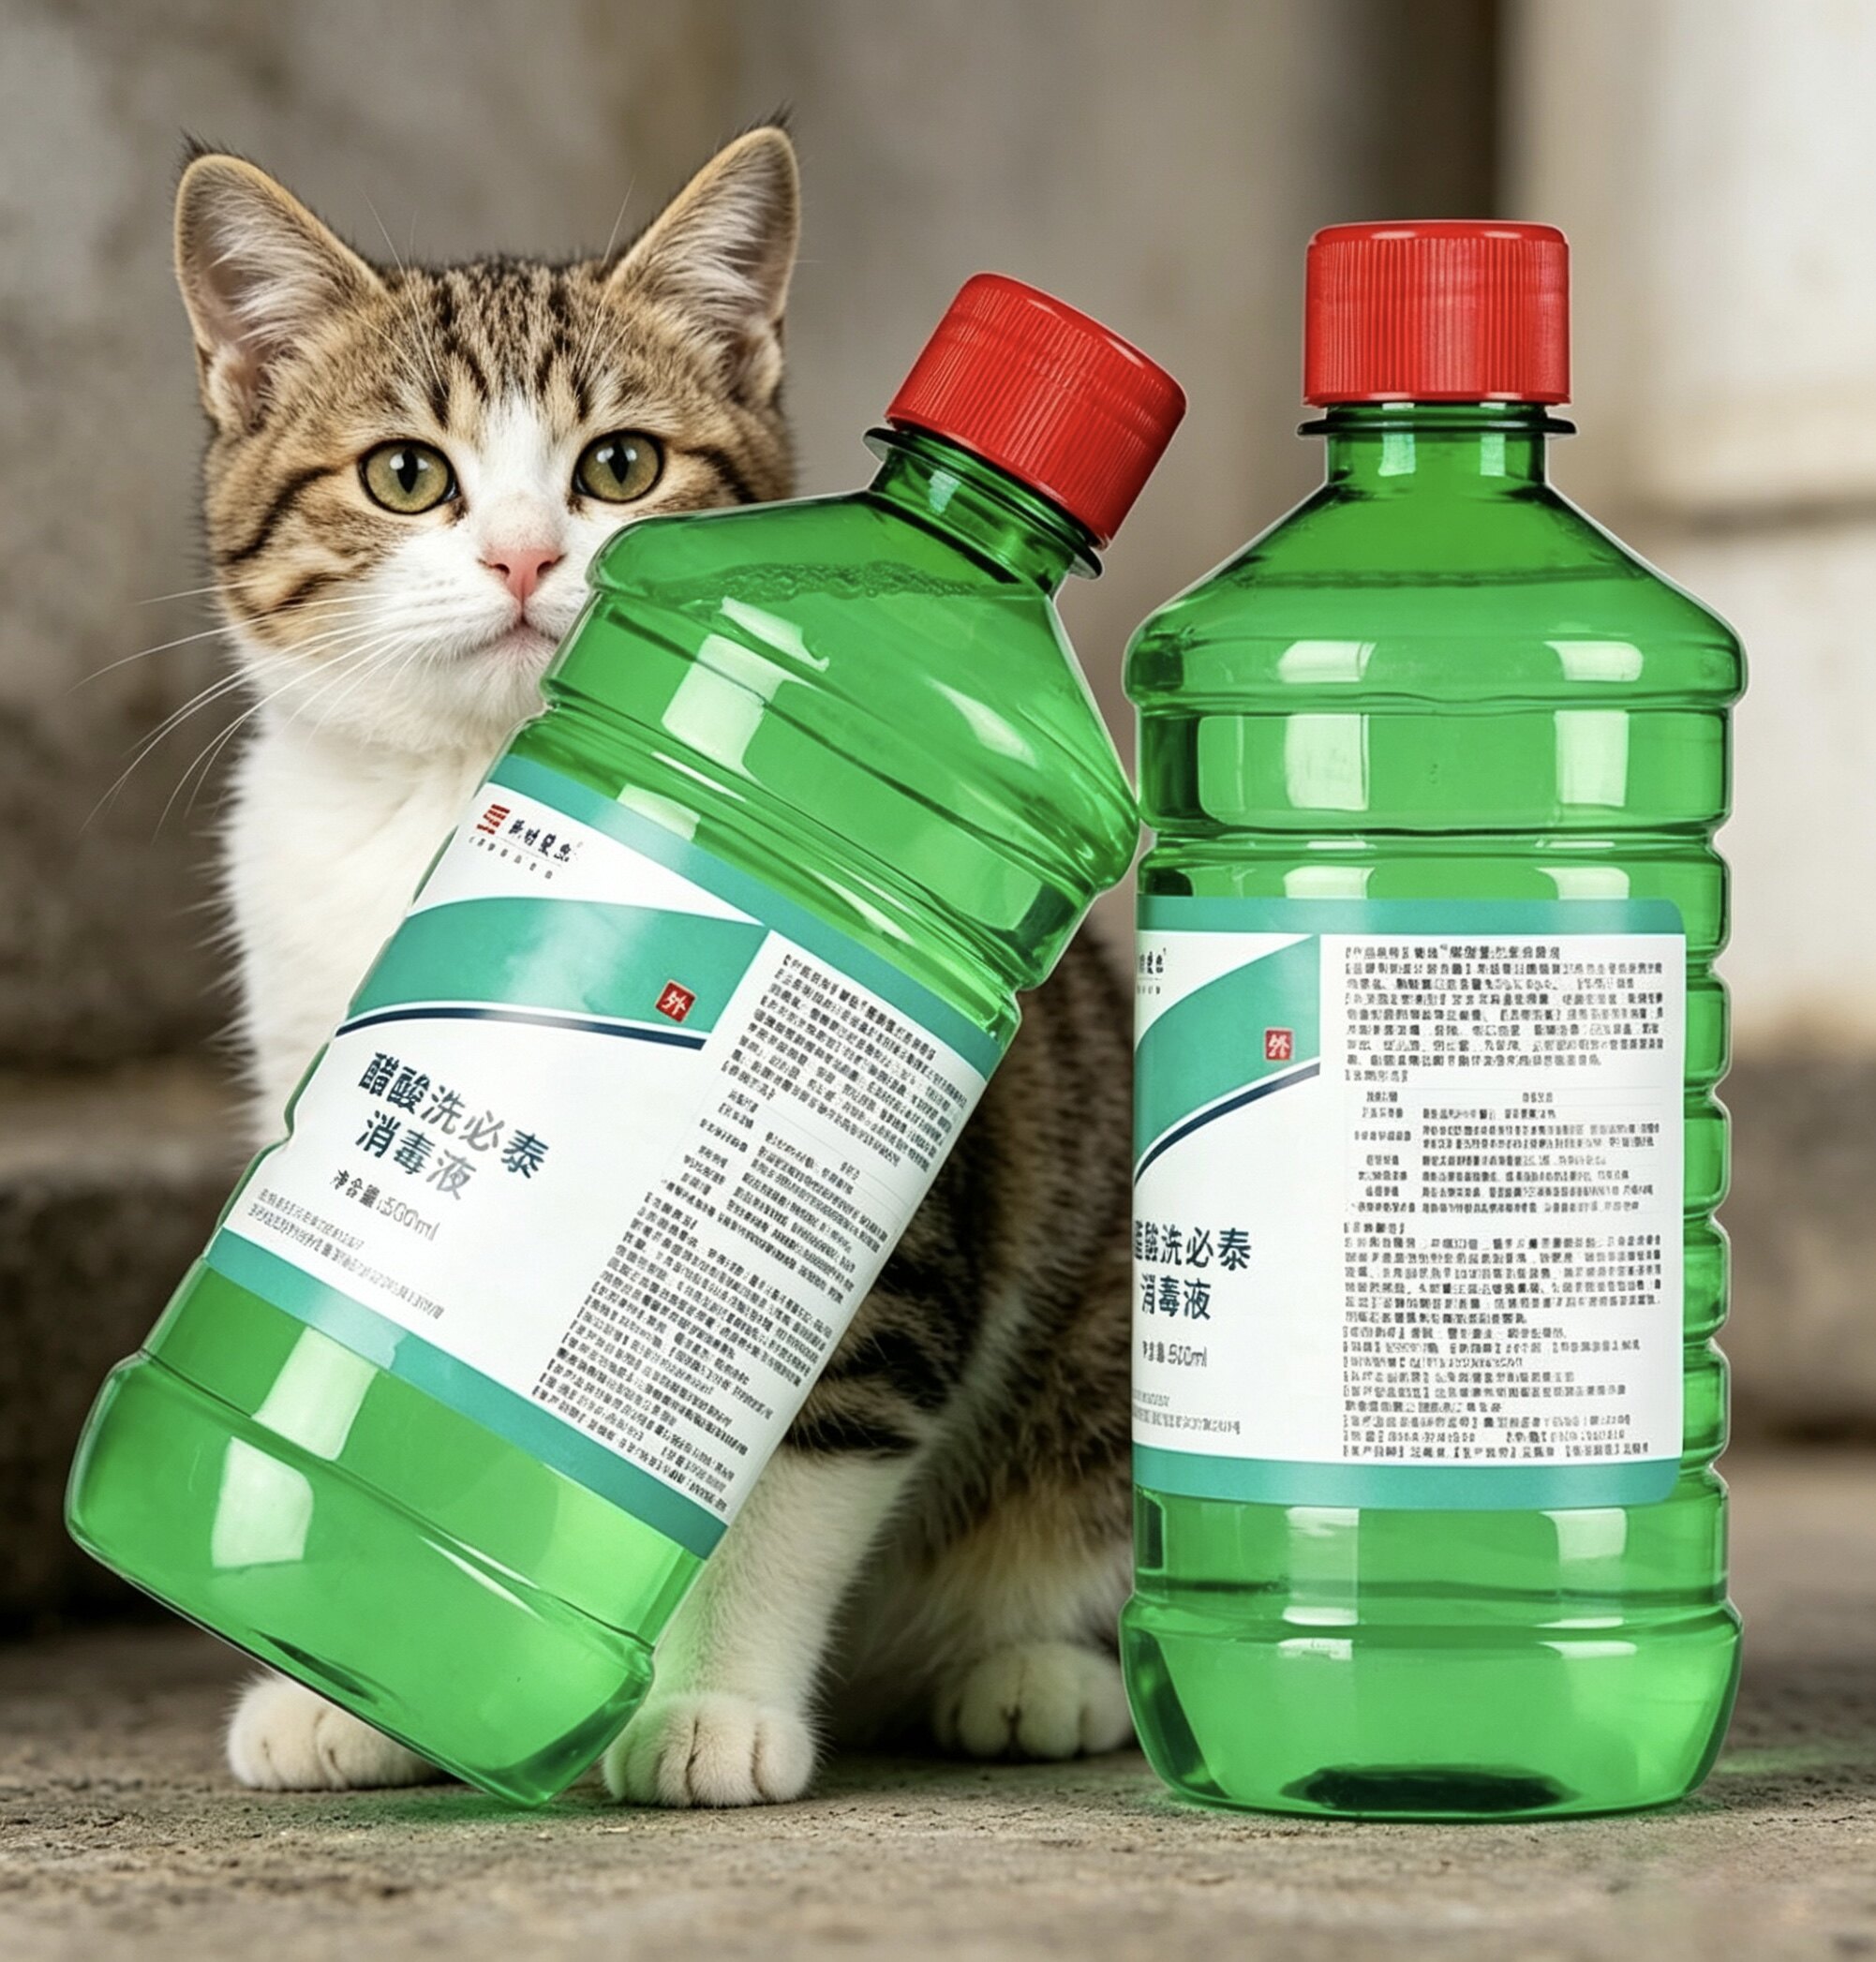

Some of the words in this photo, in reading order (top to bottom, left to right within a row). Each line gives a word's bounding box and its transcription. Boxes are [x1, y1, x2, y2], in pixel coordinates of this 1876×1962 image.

[355, 1109, 477, 1200] 消毒液
[358, 1051, 549, 1179] 醋酸洗必泰
[1140, 1272, 1212, 1320] 消毒液
